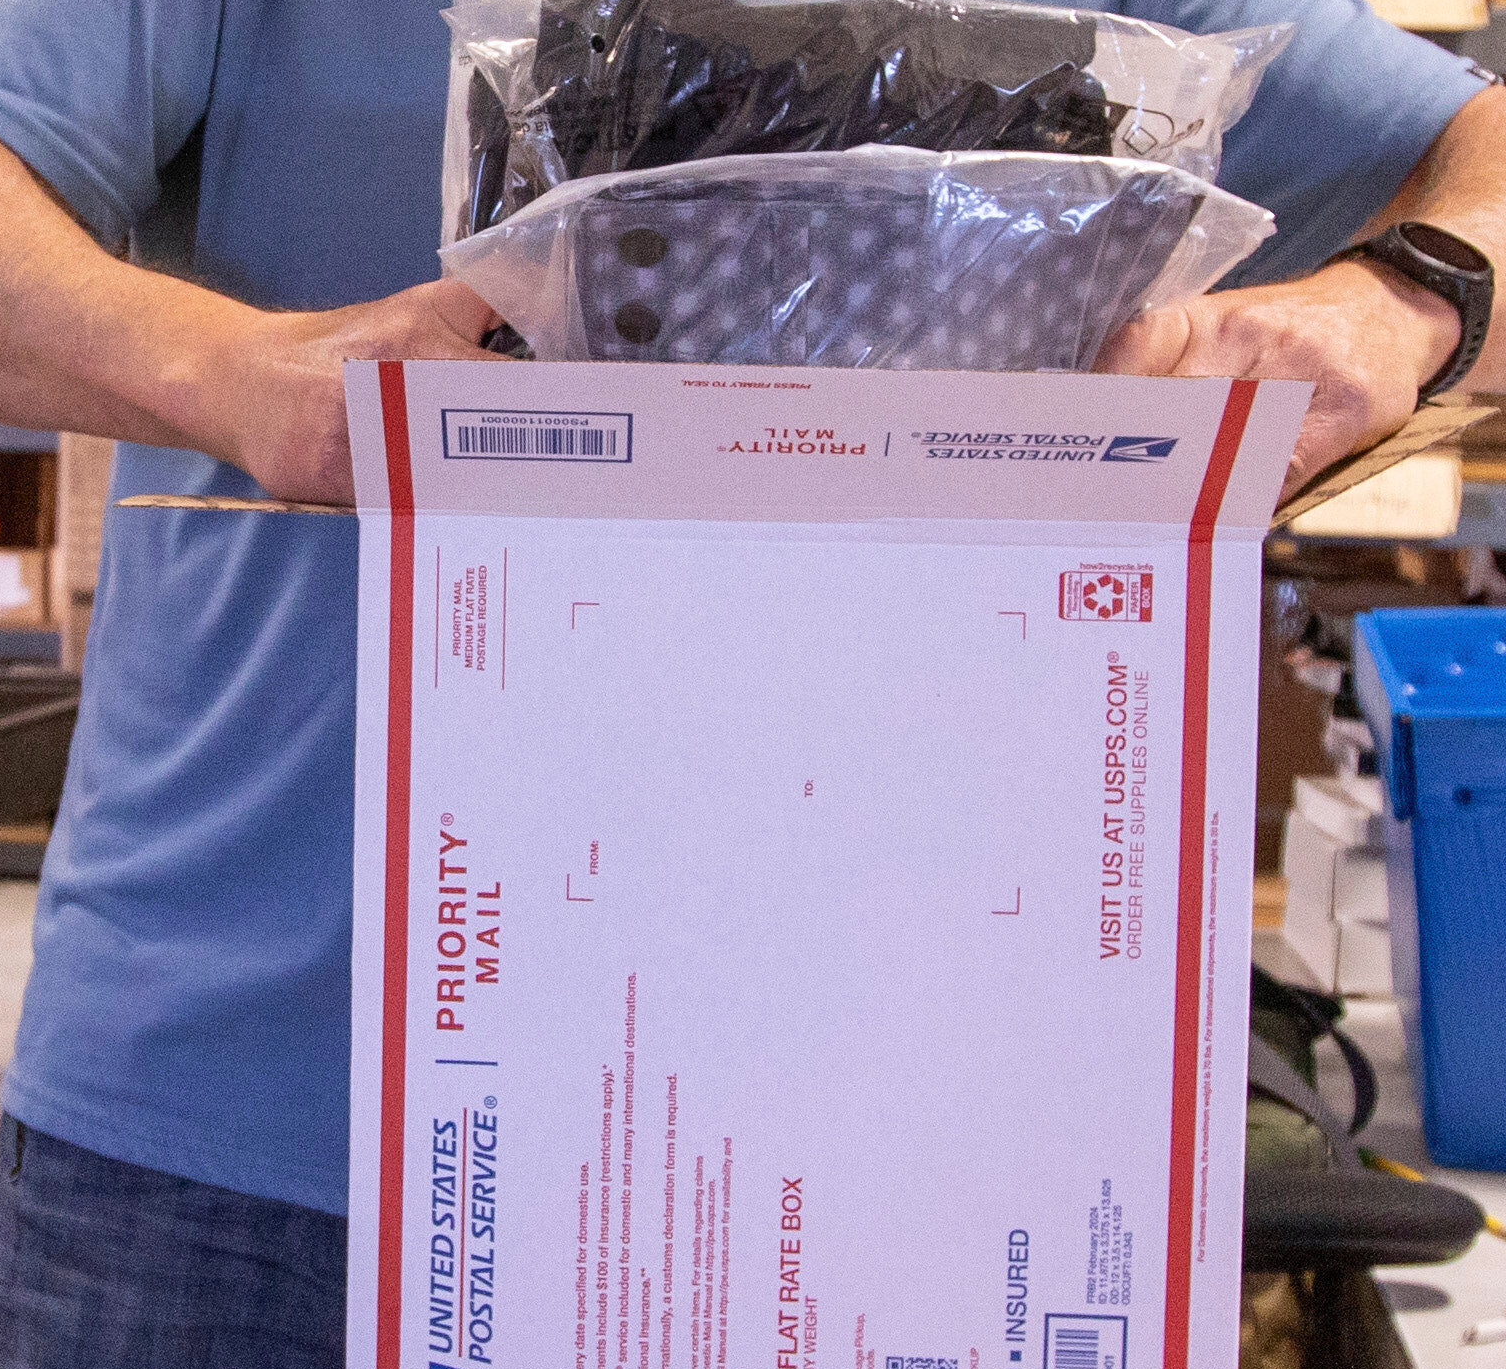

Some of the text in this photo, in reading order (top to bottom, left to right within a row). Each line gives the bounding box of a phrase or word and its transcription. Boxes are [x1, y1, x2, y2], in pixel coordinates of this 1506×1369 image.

[680, 379, 709, 387] SEAL
[711, 380, 726, 388] TO
[729, 381, 771, 389] FIRMLY
[480, 415, 589, 426] PS00011000001
[764, 427, 834, 440] MAIL
[1017, 433, 1106, 445] POSTAL
[925, 447, 1095, 461] UNITED STATES
[451, 578, 462, 656] PRIORITY MAIL
[463, 567, 475, 668] MEDIUM FLAT RATE
[476, 564, 487, 671] POSTAGE REQUIRED
[1129, 581, 1139, 613] PAPER
[1141, 587, 1151, 609] BOX
[803, 779, 814, 798] TO:
[1099, 650, 1128, 960] VISIT US AT USPS.COM®
[1124, 670, 1149, 960] ORDER FREE SUPPLIES ONLINE
[588, 840, 599, 875] FROM:
[474, 881, 501, 983] MAIL
[623, 971, 636, 1048] destinations.
[621, 1050, 635, 1125] international
[665, 1072, 678, 1126] required.
[598, 1111, 612, 1183] (restrictions
[623, 1127, 635, 1160] many
[663, 1141, 675, 1170] form
[664, 1128, 676, 1139] is
[579, 1160, 589, 1186] use.
[620, 1162, 632, 1186] and
[576, 1188, 589, 1244] domestic
[597, 1184, 610, 1243] insurance
[618, 1188, 631, 1245] domestic
[662, 1172, 675, 1240] declaration
[780, 1176, 802, 1231] BOX
[428, 1117, 457, 1357] UNITED STATES
[467, 1095, 497, 1364] POSTAL SERVICE®
[597, 1245, 609, 1259] of
[575, 1246, 587, 1264] for
[595, 1260, 608, 1290] $100
[617, 1246, 630, 1264] for
[661, 1241, 673, 1294] customs
[778, 1238, 801, 1302] RATE
[574, 1265, 588, 1320] specified
[616, 1265, 630, 1318] included
[662, 1295, 672, 1304] a
[1004, 1227, 1029, 1342] INSURED
[573, 1322, 586, 1350] date
[595, 1291, 608, 1336] include
[803, 1294, 817, 1354] WEIGHT
[853, 1312, 865, 1348] Pickup,
[616, 1319, 629, 1363] service
[776, 1309, 799, 1369] FLAT
